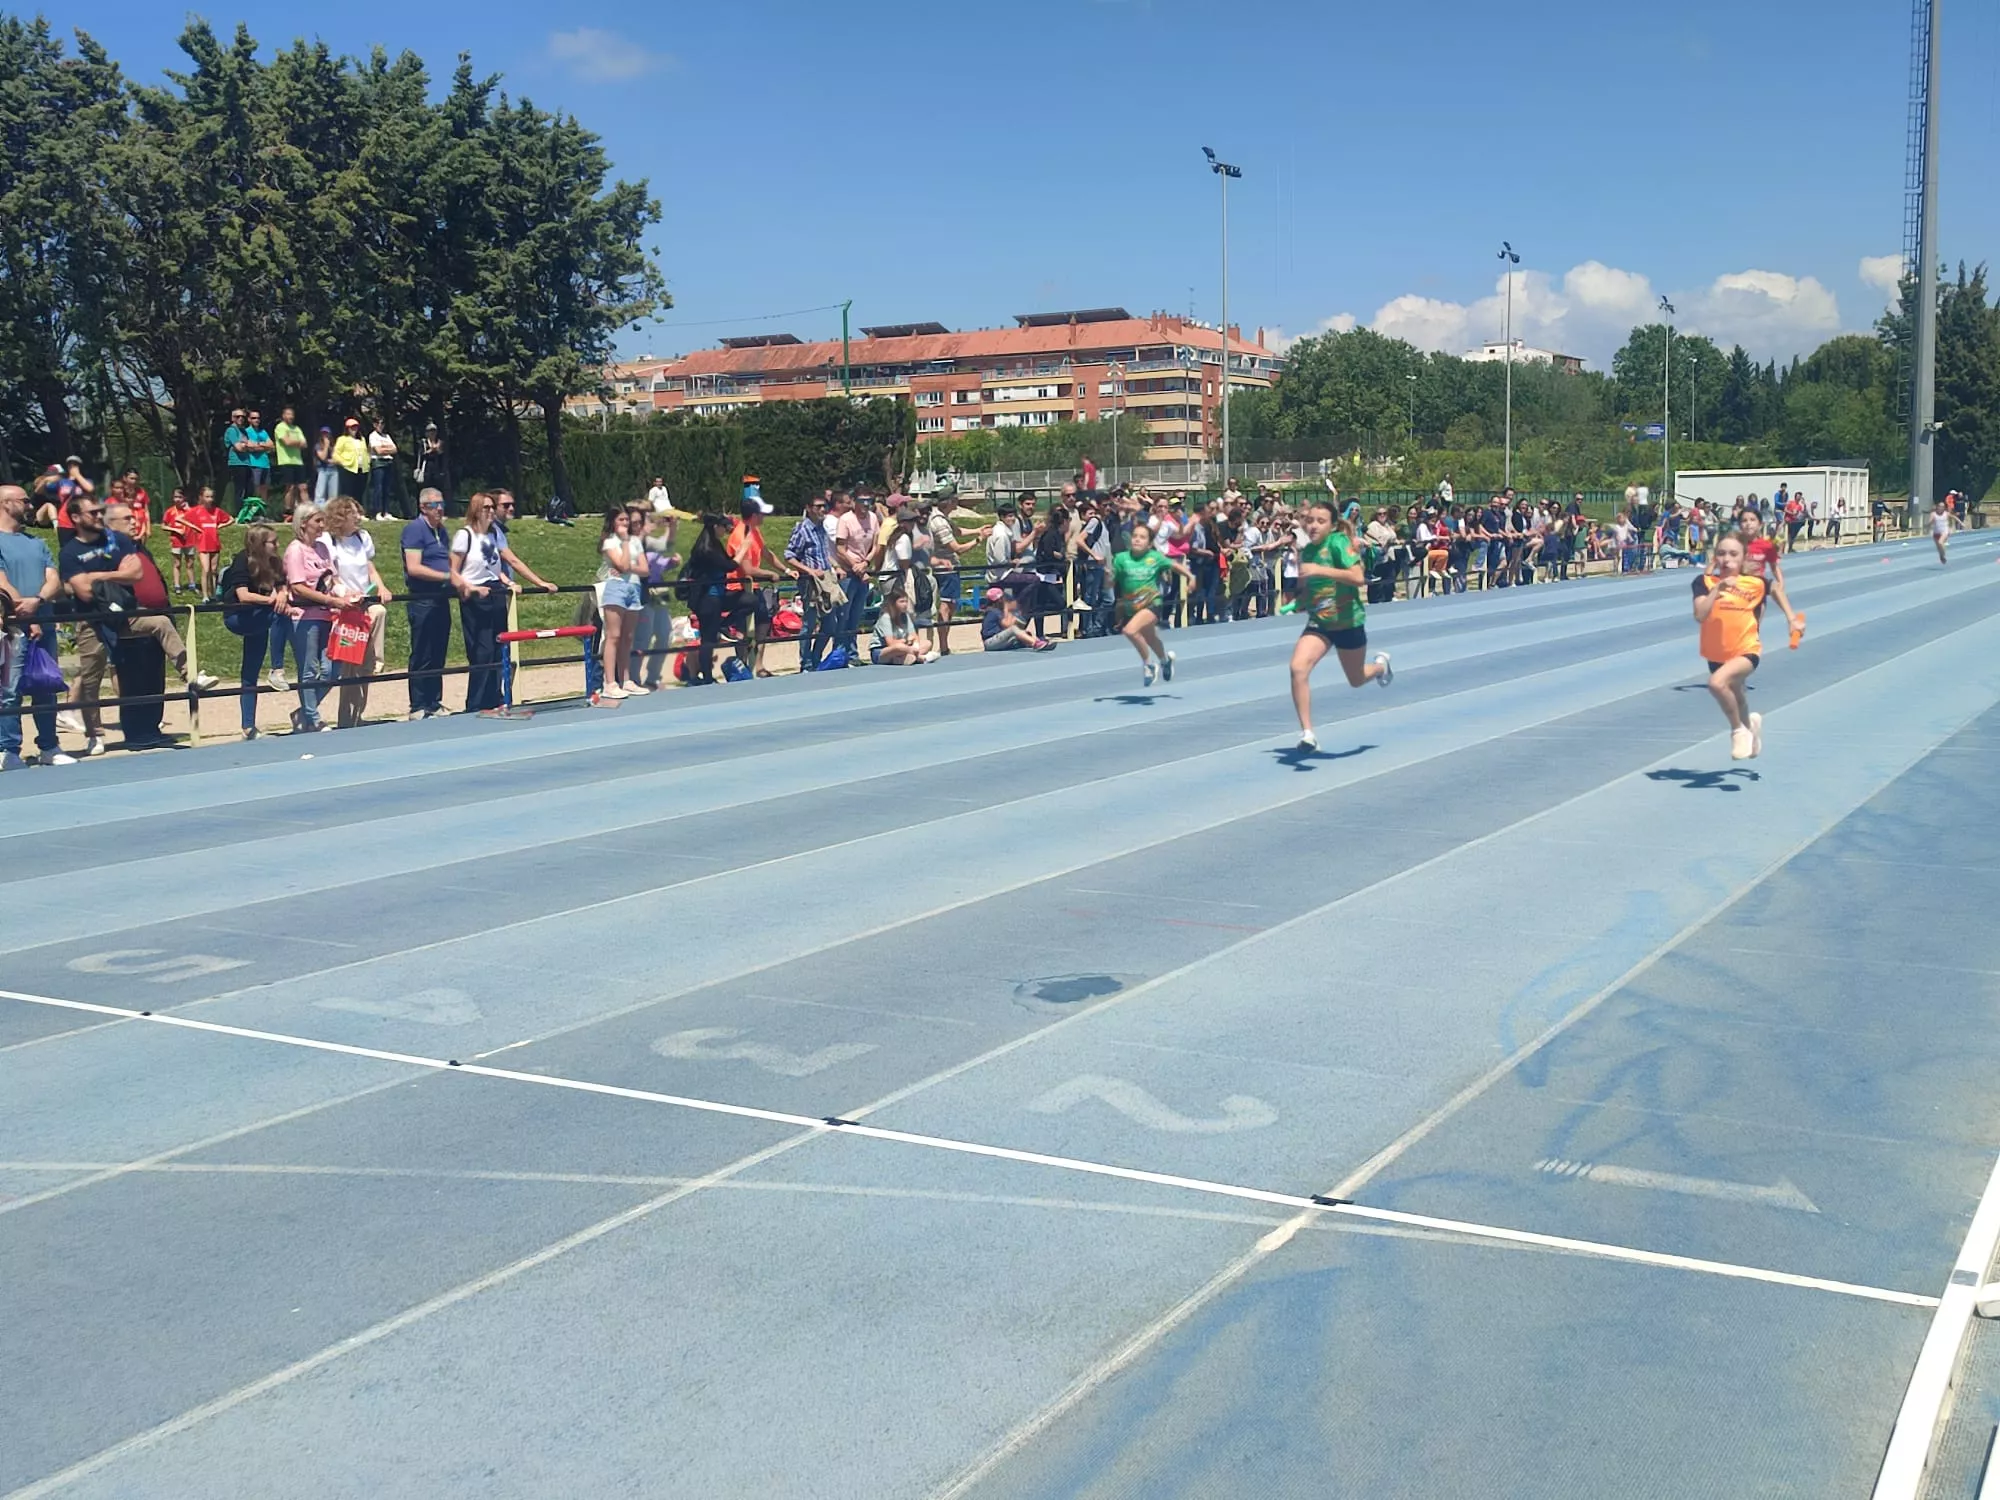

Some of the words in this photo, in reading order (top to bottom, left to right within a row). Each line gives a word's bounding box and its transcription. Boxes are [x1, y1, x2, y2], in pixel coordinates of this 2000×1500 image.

[65, 949, 256, 983] 5
[650, 1026, 878, 1077] 3
[1024, 1074, 1279, 1133] 2
[1531, 1158, 1822, 1214] 1
